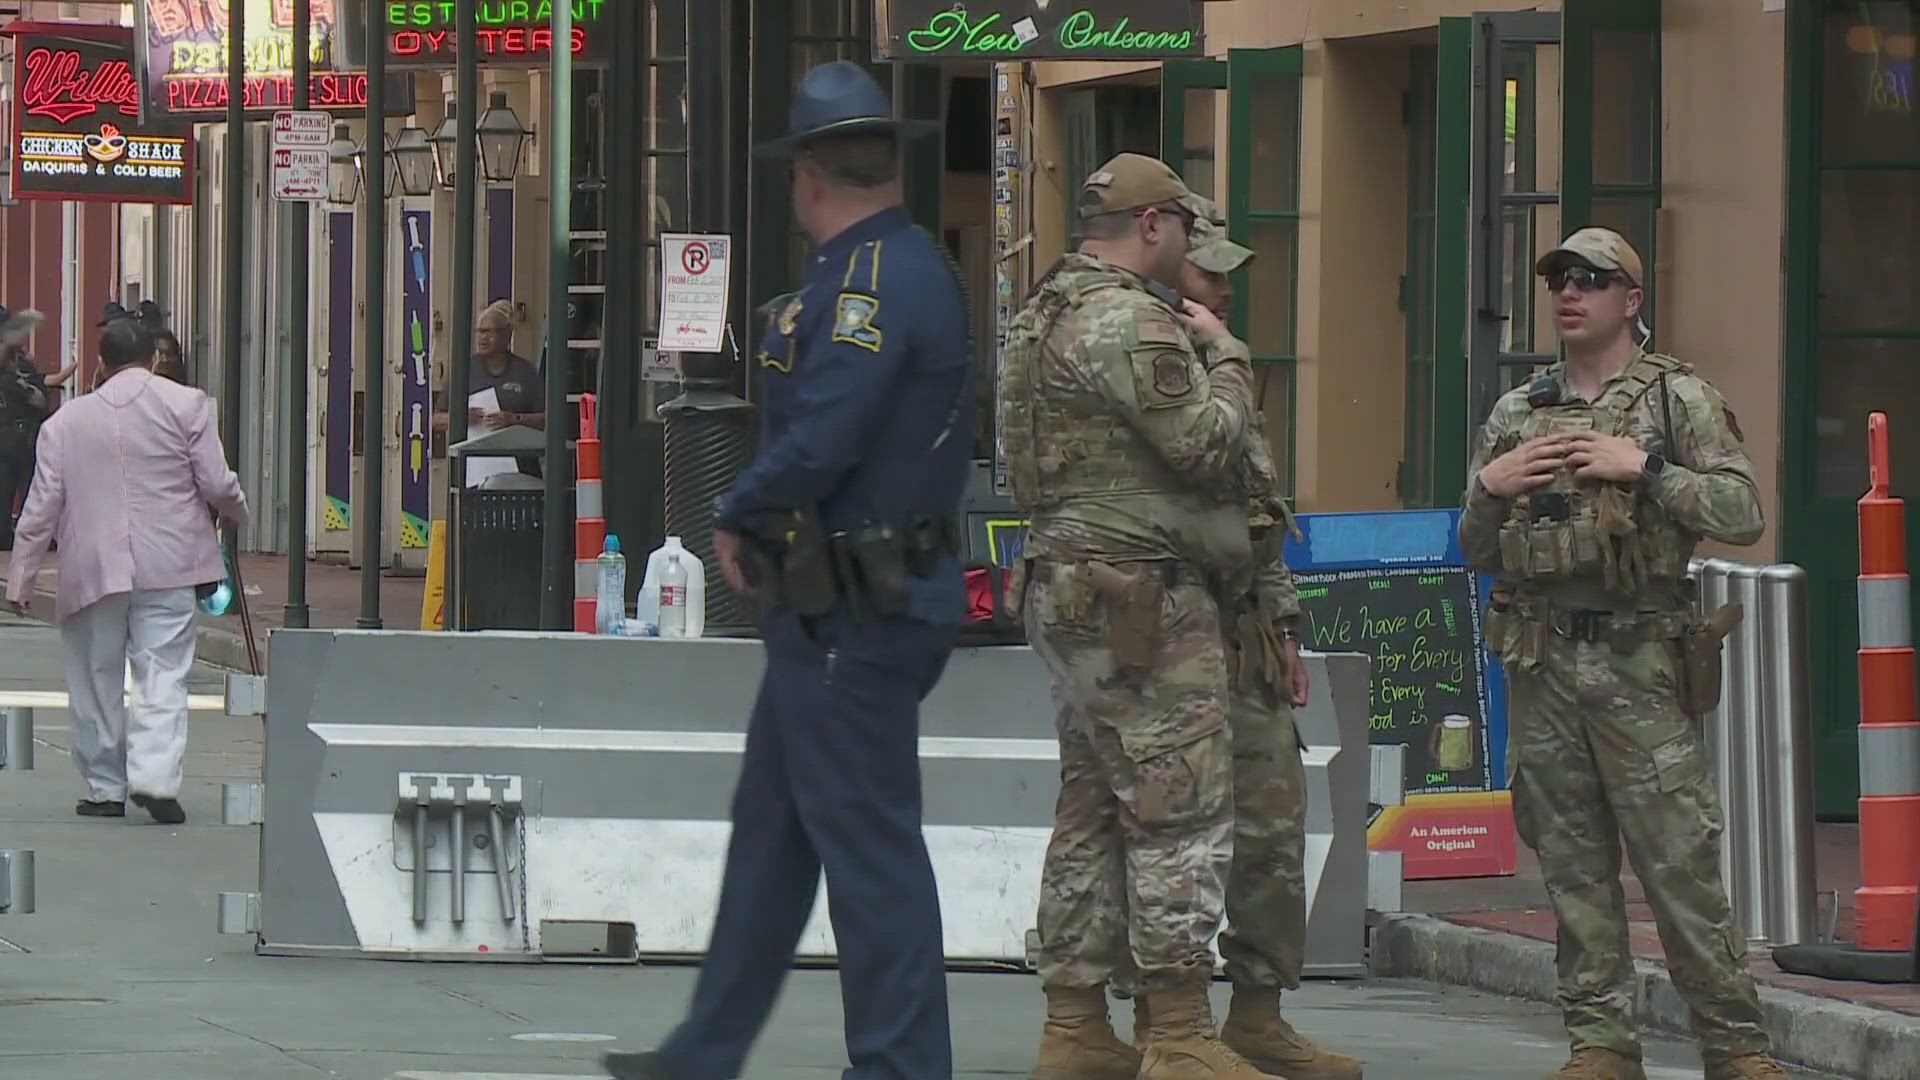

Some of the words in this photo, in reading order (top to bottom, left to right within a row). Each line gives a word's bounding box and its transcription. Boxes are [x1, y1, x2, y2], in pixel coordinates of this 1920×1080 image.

[393, 28, 585, 54] OYTERS
[1060, 10, 1191, 49] Orleans
[168, 79, 229, 109] PIZZA
[319, 75, 368, 103] SLIC
[276, 117, 292, 129] NO
[293, 115, 327, 129] PARKING
[21, 137, 83, 157] CHICKEN
[127, 141, 182, 161] SHACK
[275, 152, 291, 166] NO
[22, 160, 88, 176] DAIQUIRIS
[95, 163, 106, 176] &
[113, 164, 147, 177] COLD
[149, 166, 182, 178] BEER
[1309, 606, 1351, 647] We
[1359, 605, 1407, 640] have
[1415, 608, 1437, 629] a
[1377, 641, 1406, 673] for
[1410, 636, 1465, 683] Every
[1381, 677, 1425, 709] Every
[1409, 710, 1429, 725] is
[1410, 827, 1428, 838] An
[1430, 825, 1488, 838] American
[1427, 839, 1476, 851] Original
